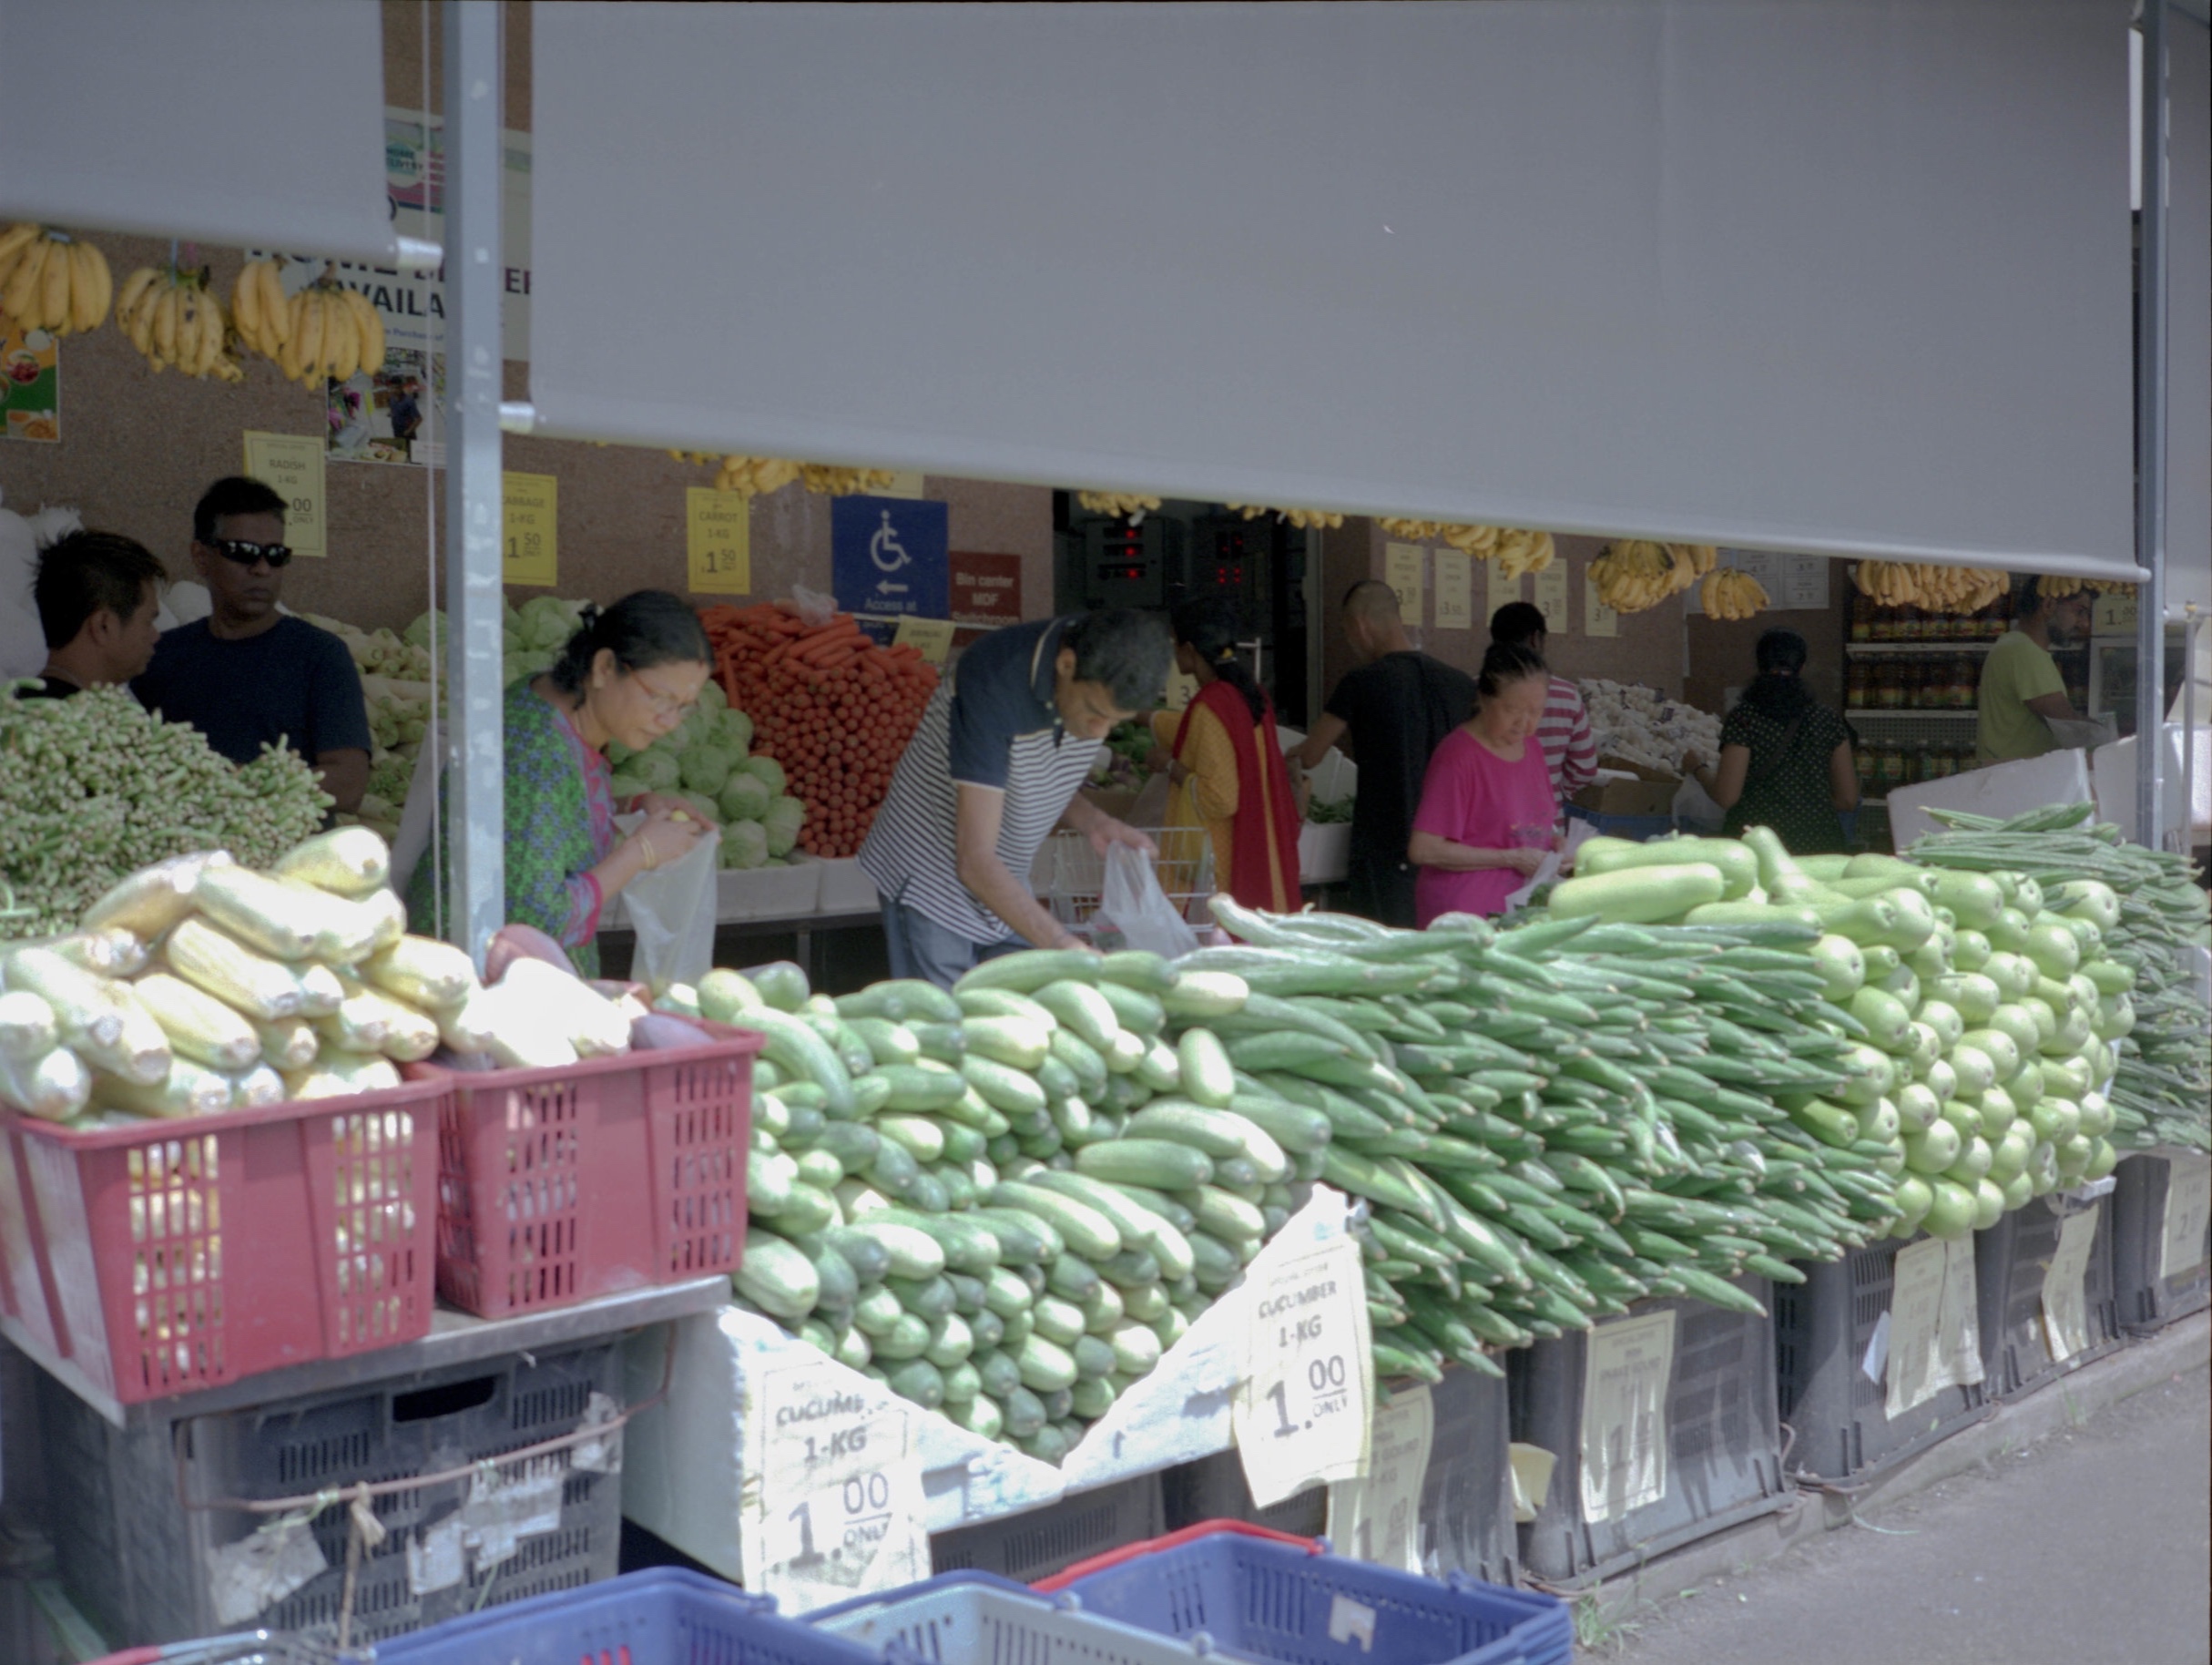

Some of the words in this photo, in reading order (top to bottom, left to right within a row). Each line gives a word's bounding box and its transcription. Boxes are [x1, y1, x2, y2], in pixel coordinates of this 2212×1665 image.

[269, 458, 307, 471] RADISH
[292, 497, 312, 512] 00
[698, 511, 738, 524] CARROT
[955, 572, 975, 587] Bin
[978, 575, 1014, 587] center
[864, 597, 903, 612] Access
[906, 600, 917, 612] at
[972, 592, 1000, 606] MDF
[1258, 1280, 1337, 1320] CUCUMBER
[1279, 1313, 1322, 1350] 1-KG
[1308, 1354, 1346, 1392] 00
[1311, 1394, 1348, 1418] ONLY
[803, 1425, 869, 1466] 1-KG
[842, 1470, 890, 1516] 00
